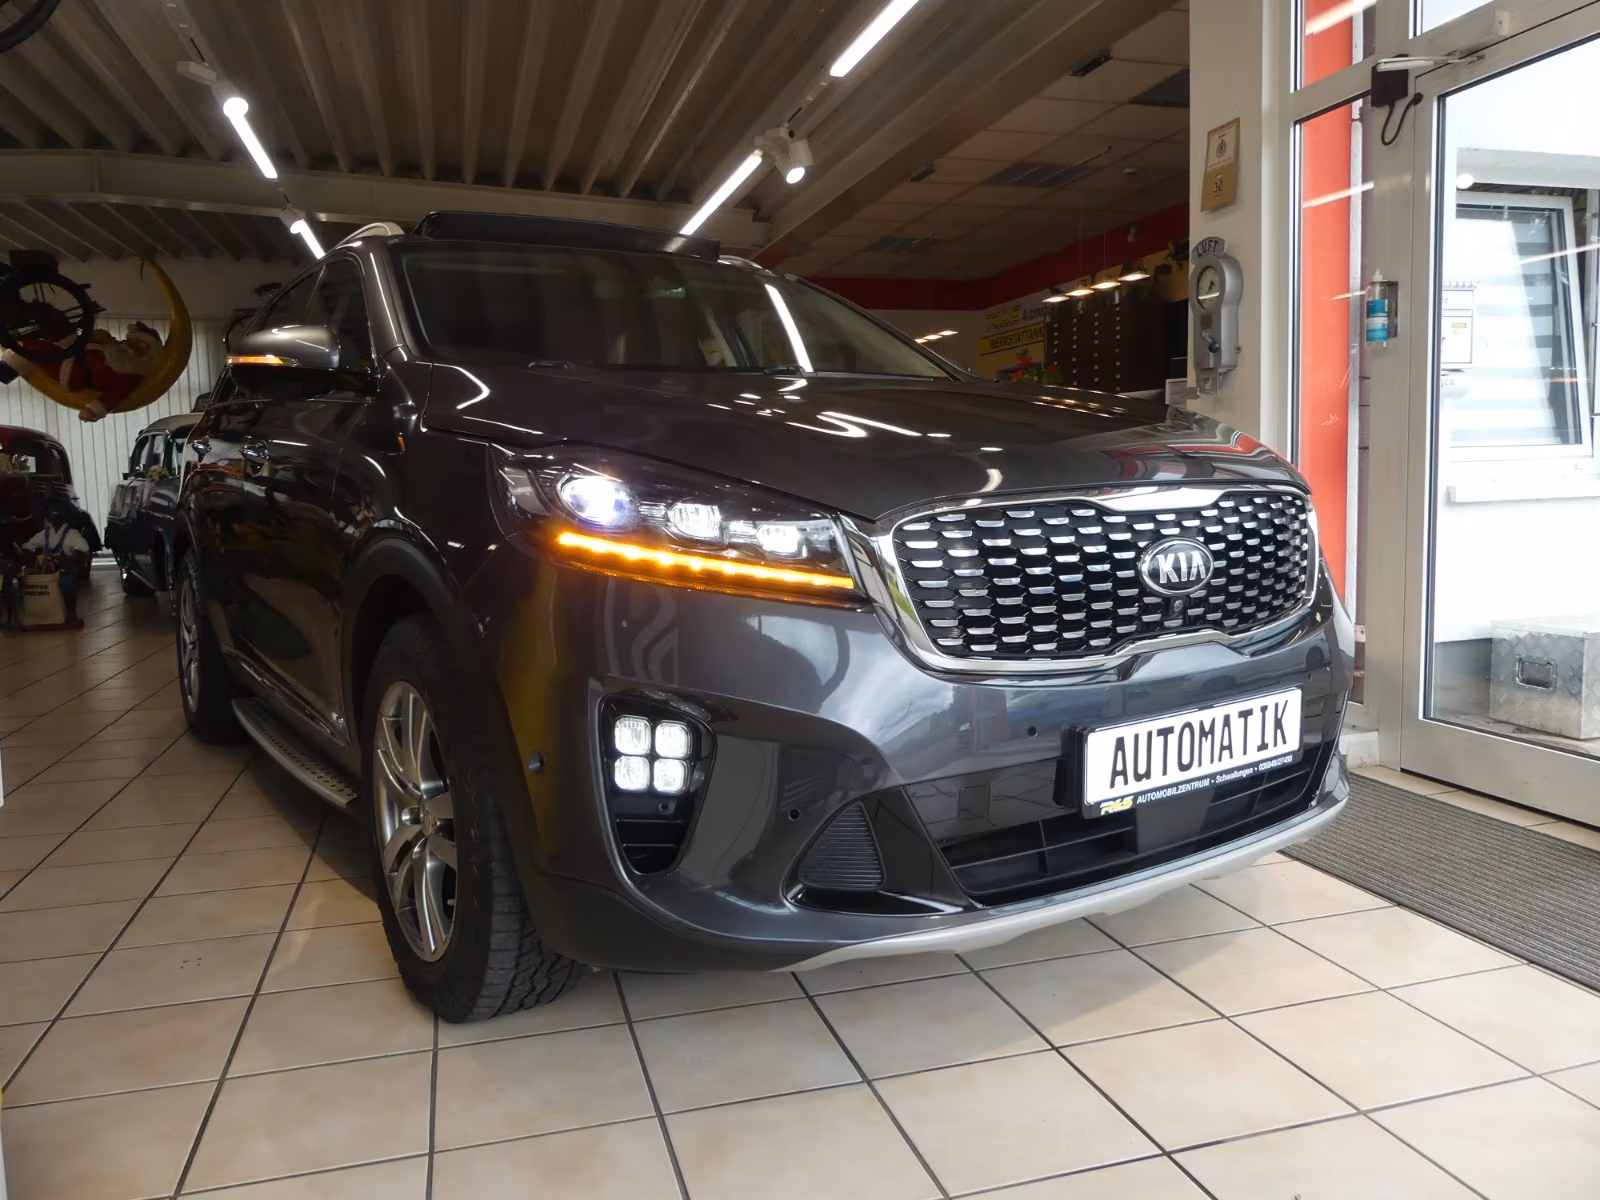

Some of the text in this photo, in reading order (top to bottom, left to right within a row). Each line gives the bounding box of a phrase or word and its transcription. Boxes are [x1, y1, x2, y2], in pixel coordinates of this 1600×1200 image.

[1196, 239, 1218, 258] LUFT
[1156, 550, 1206, 584] KIA
[1109, 699, 1289, 789] AUTOMATIK
[1136, 778, 1210, 805] AUTOMOBILZENTRUM
